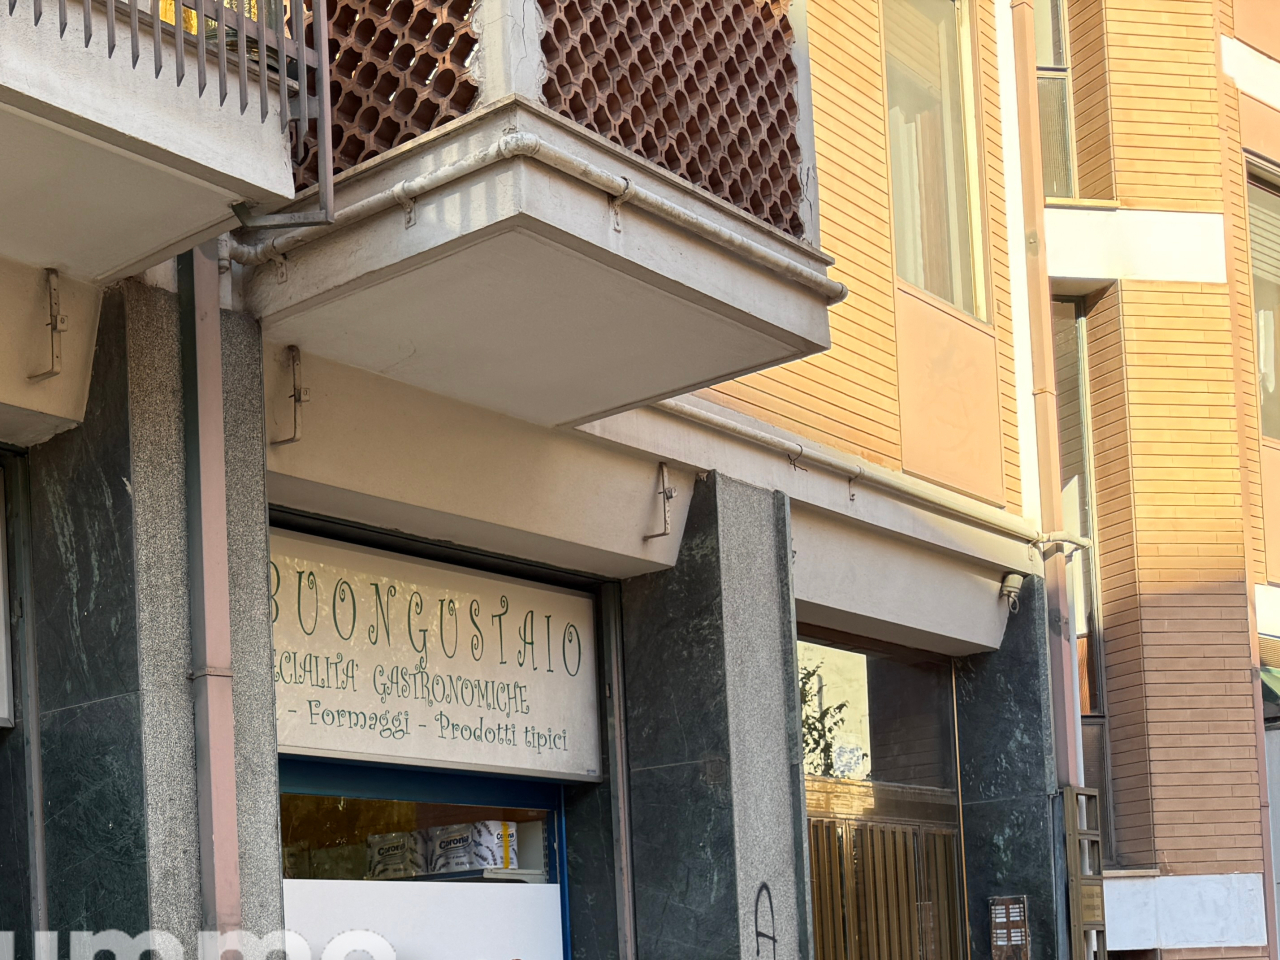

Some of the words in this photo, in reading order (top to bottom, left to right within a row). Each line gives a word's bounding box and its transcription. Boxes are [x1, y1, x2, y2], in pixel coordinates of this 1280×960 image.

[372, 663, 531, 719] GASTRONOMICHE
[306, 699, 411, 741] Formaggi
[434, 710, 518, 747] Prodotti
[523, 725, 569, 755] tipici
[439, 834, 470, 850] Corona
